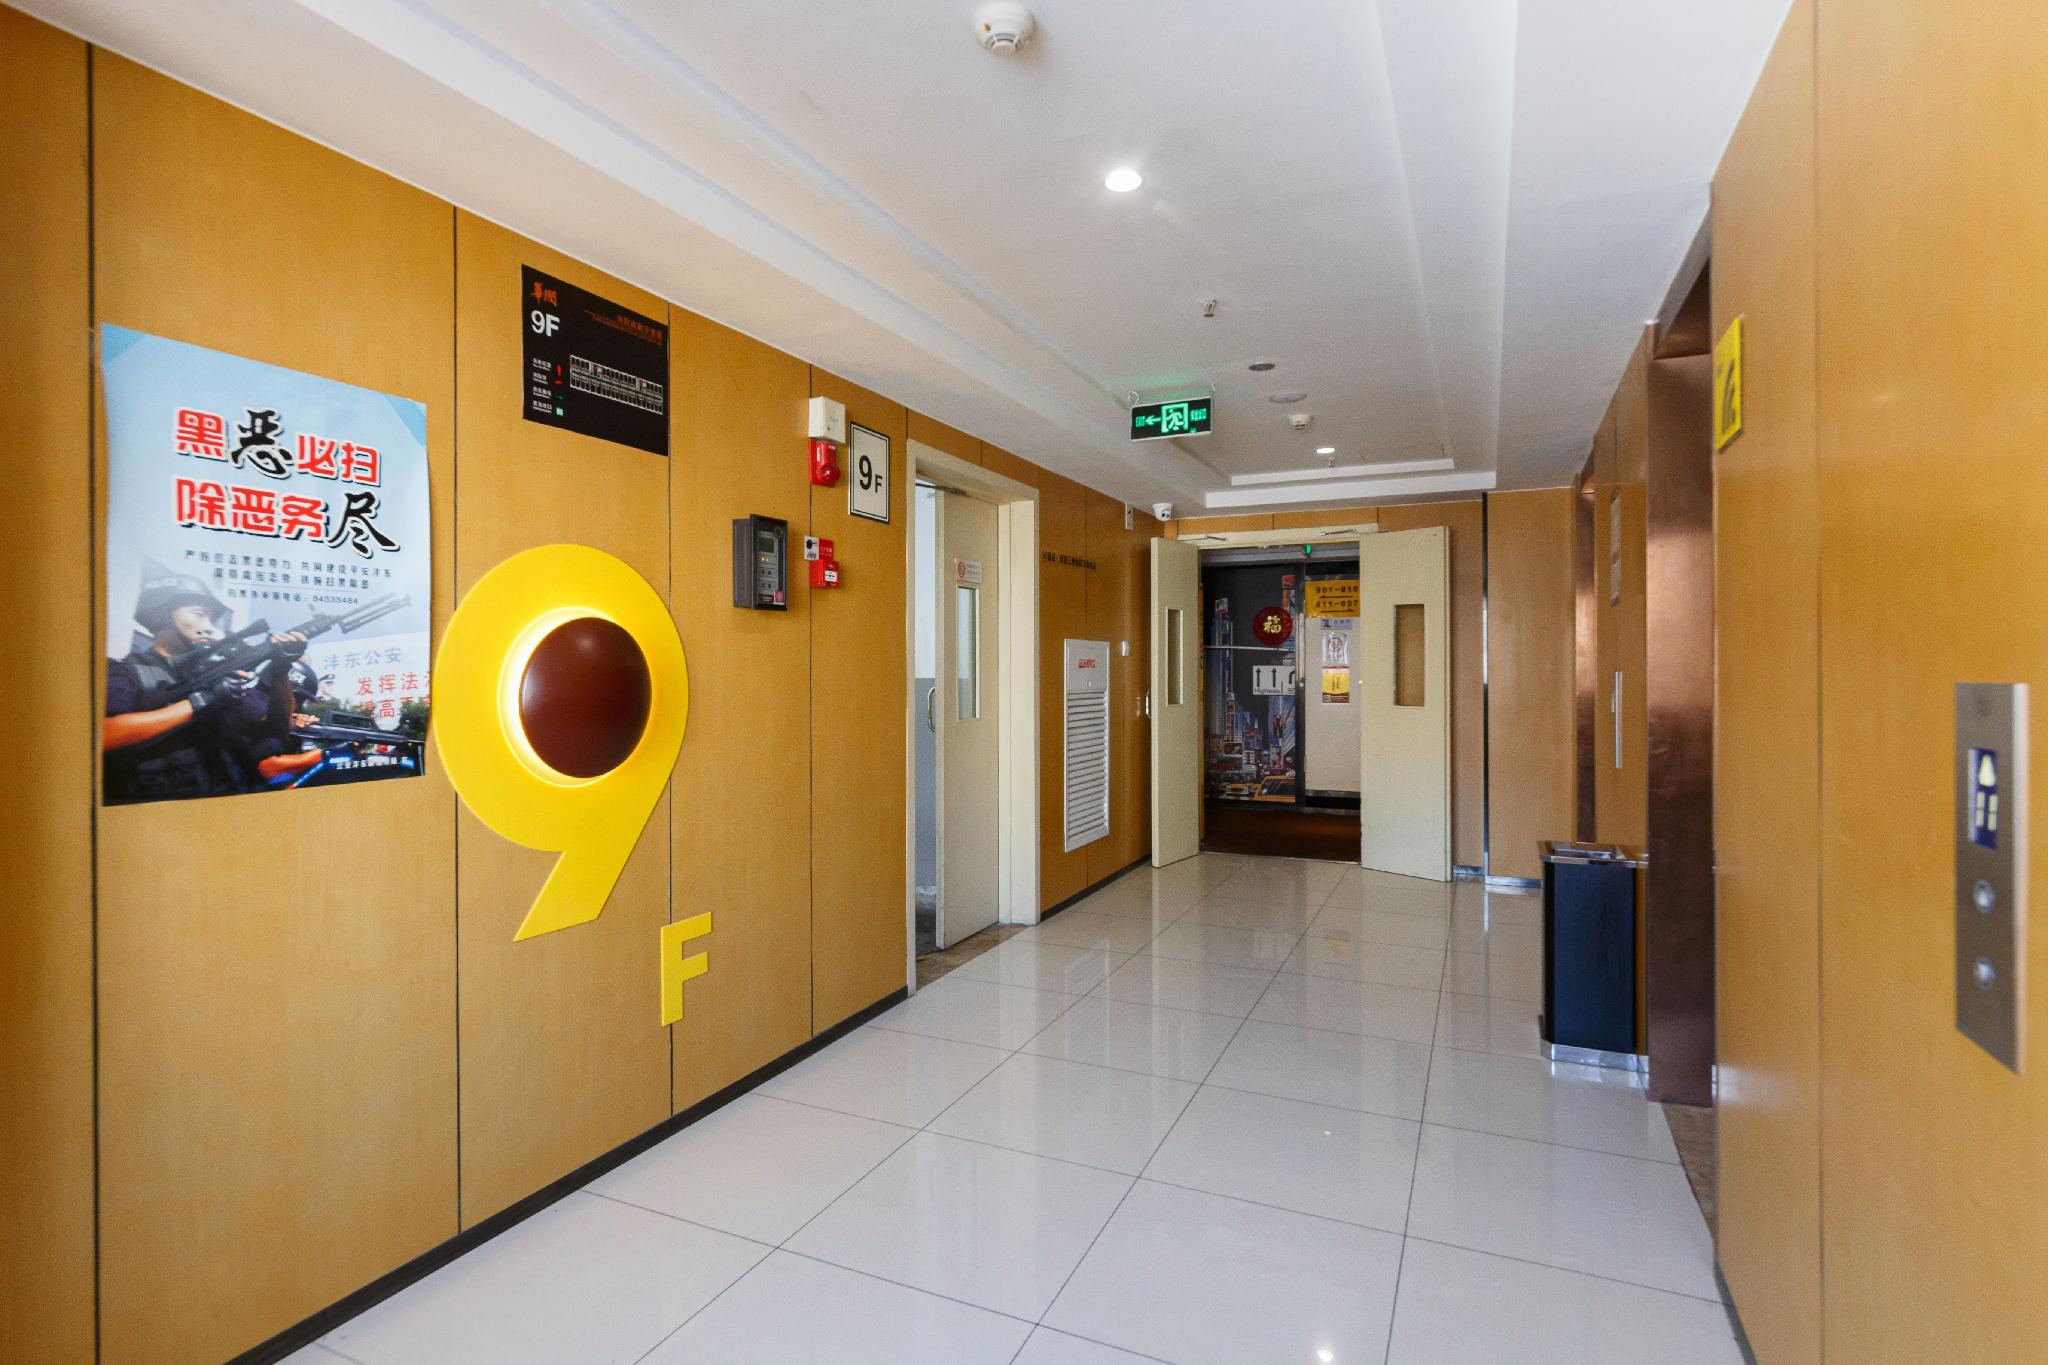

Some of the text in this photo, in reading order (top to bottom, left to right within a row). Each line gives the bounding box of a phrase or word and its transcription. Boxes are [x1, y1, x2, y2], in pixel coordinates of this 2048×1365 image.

[530, 309, 560, 338] 9F
[175, 408, 380, 485] 黑恶必扫
[859, 455, 883, 493] 9F
[175, 478, 397, 557] 除恶务尽
